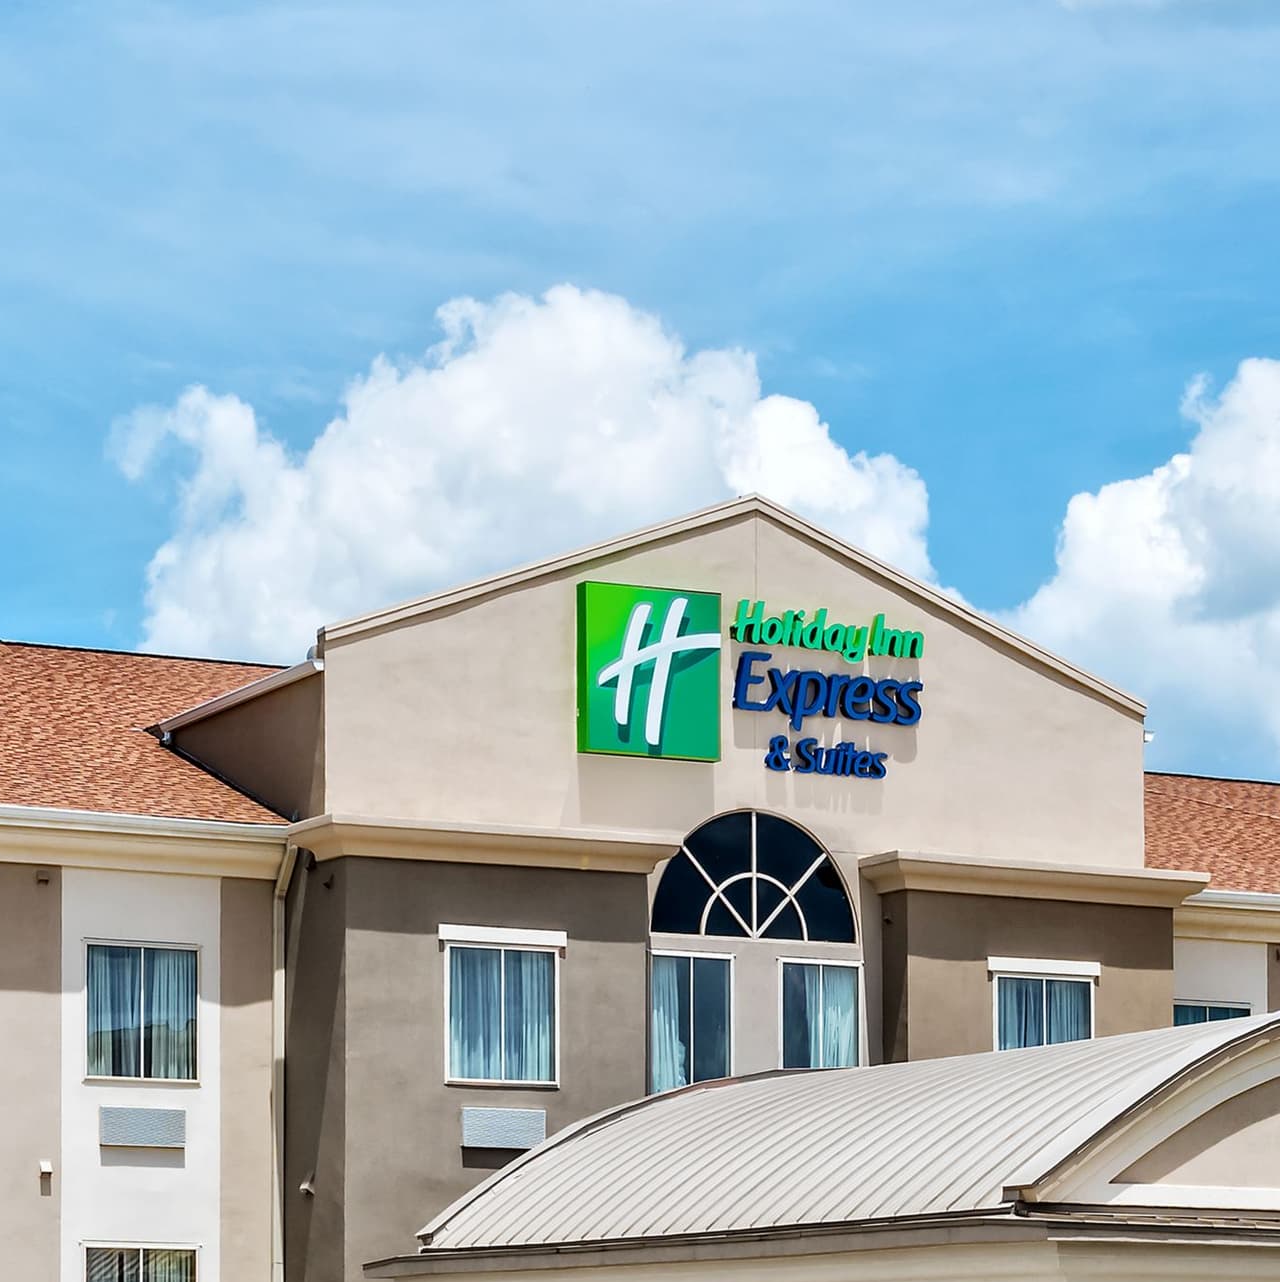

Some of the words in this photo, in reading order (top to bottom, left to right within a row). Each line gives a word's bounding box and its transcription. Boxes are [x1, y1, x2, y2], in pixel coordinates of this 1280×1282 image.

[730, 599, 869, 664] Holiday
[869, 613, 924, 659] Inn
[732, 651, 924, 731] Express
[765, 735, 791, 772] &
[792, 736, 888, 780] Suites
